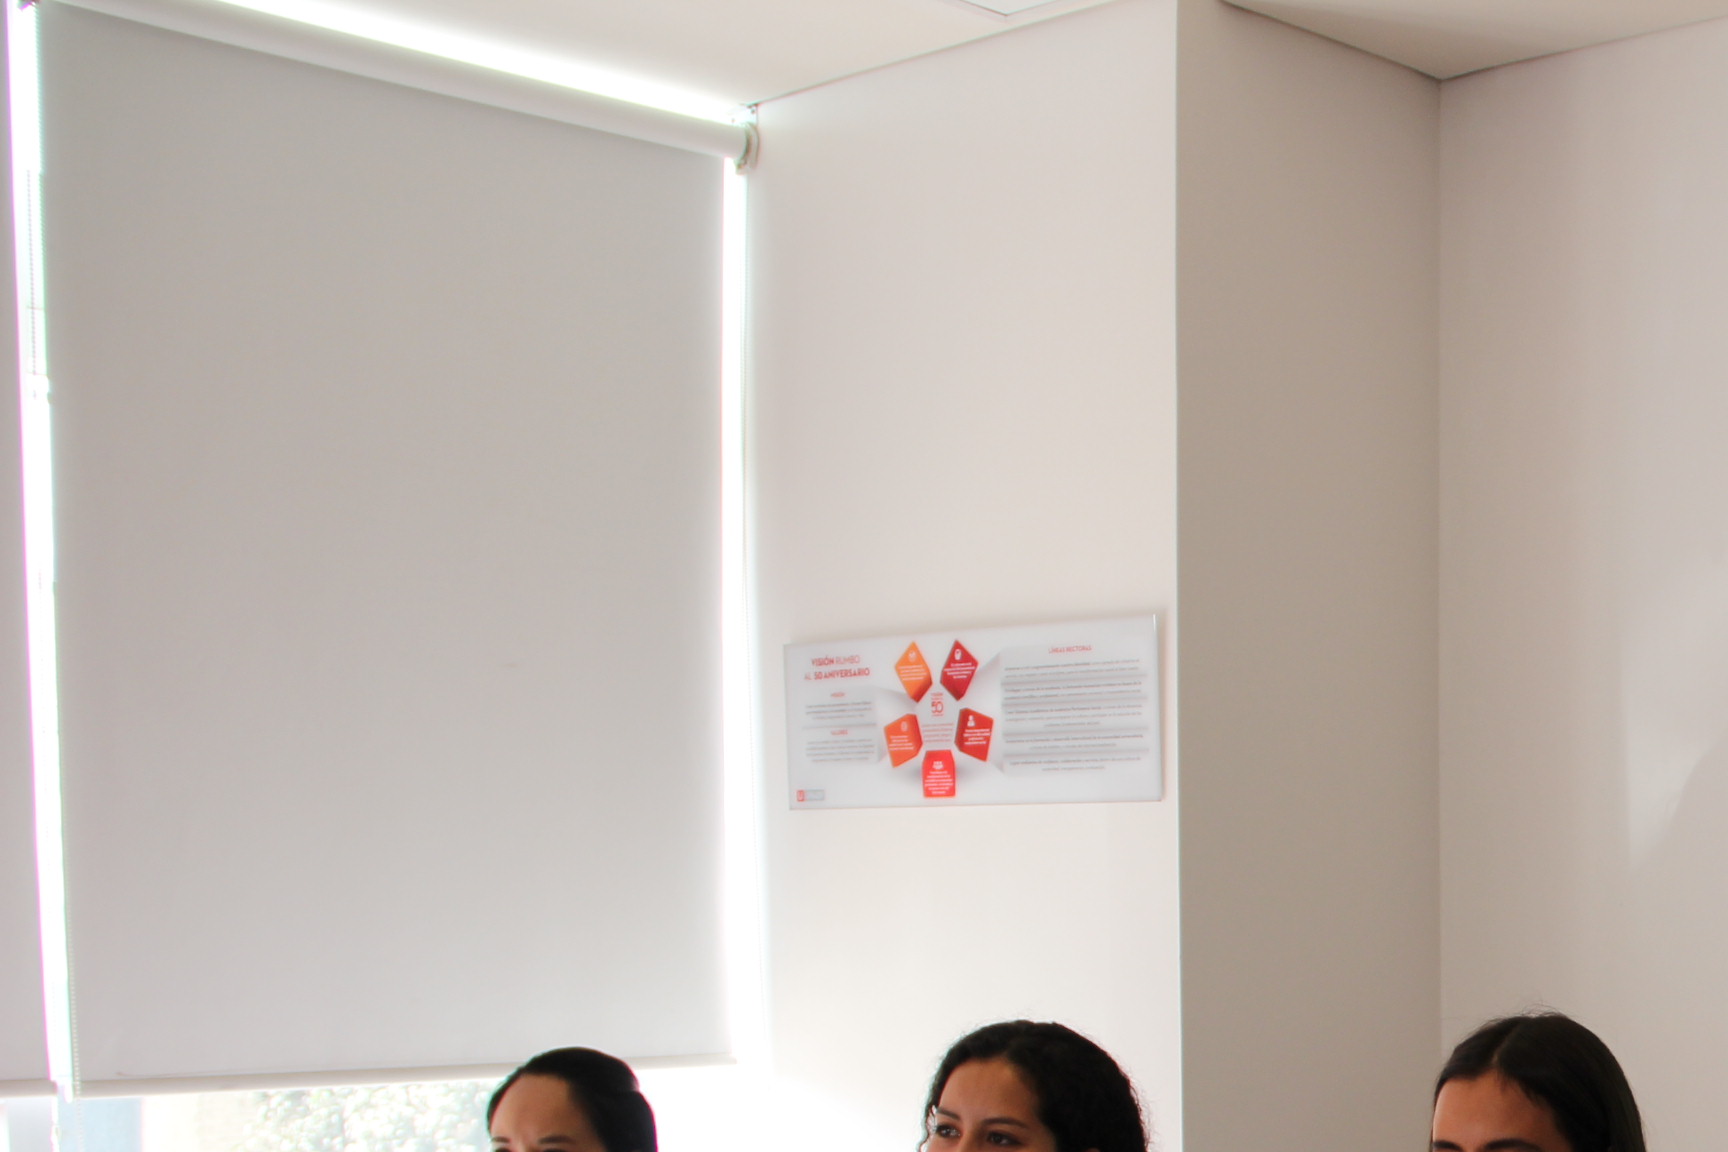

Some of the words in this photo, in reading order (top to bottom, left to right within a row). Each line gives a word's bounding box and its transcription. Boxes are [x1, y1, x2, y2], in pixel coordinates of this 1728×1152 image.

[811, 655, 834, 667] VISIÓN
[814, 671, 823, 680] 50
[824, 667, 870, 679] ANIVERSARIO
